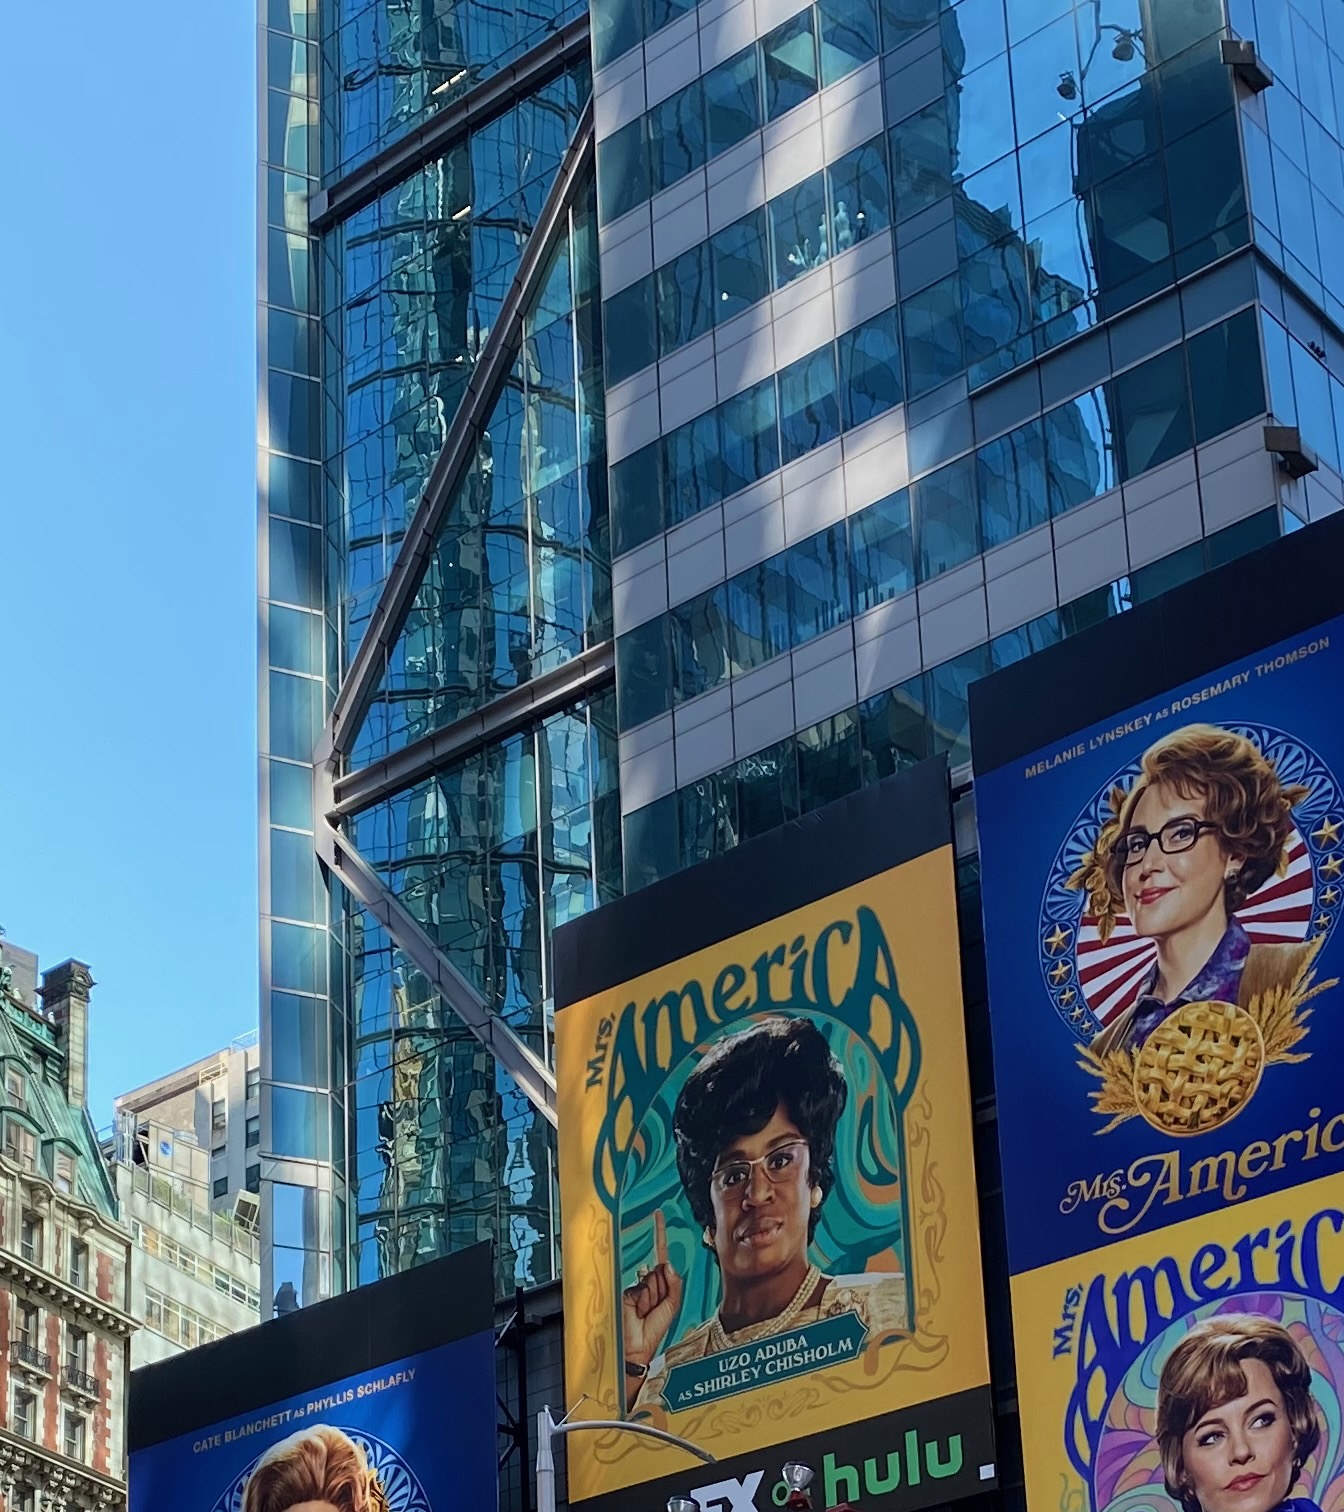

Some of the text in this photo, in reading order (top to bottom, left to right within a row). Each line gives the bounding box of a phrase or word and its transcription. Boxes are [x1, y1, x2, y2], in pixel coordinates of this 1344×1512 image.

[1025, 744, 1086, 779] MELANIE
[1090, 713, 1152, 750] LYNSKEY
[1171, 671, 1250, 714] ROSEMARY
[1254, 637, 1330, 677] THOMSON
[1058, 1168, 1127, 1215] Mrs.
[694, 1368, 762, 1399] SHIRLEY
[764, 1338, 854, 1375] CHISHOLM
[718, 1336, 808, 1375] UZO ADUBA
[193, 1368, 416, 1453] CATE BLANCHETT AS PHYLLIS SCHLAFLY
[823, 1430, 964, 1508] hulu
